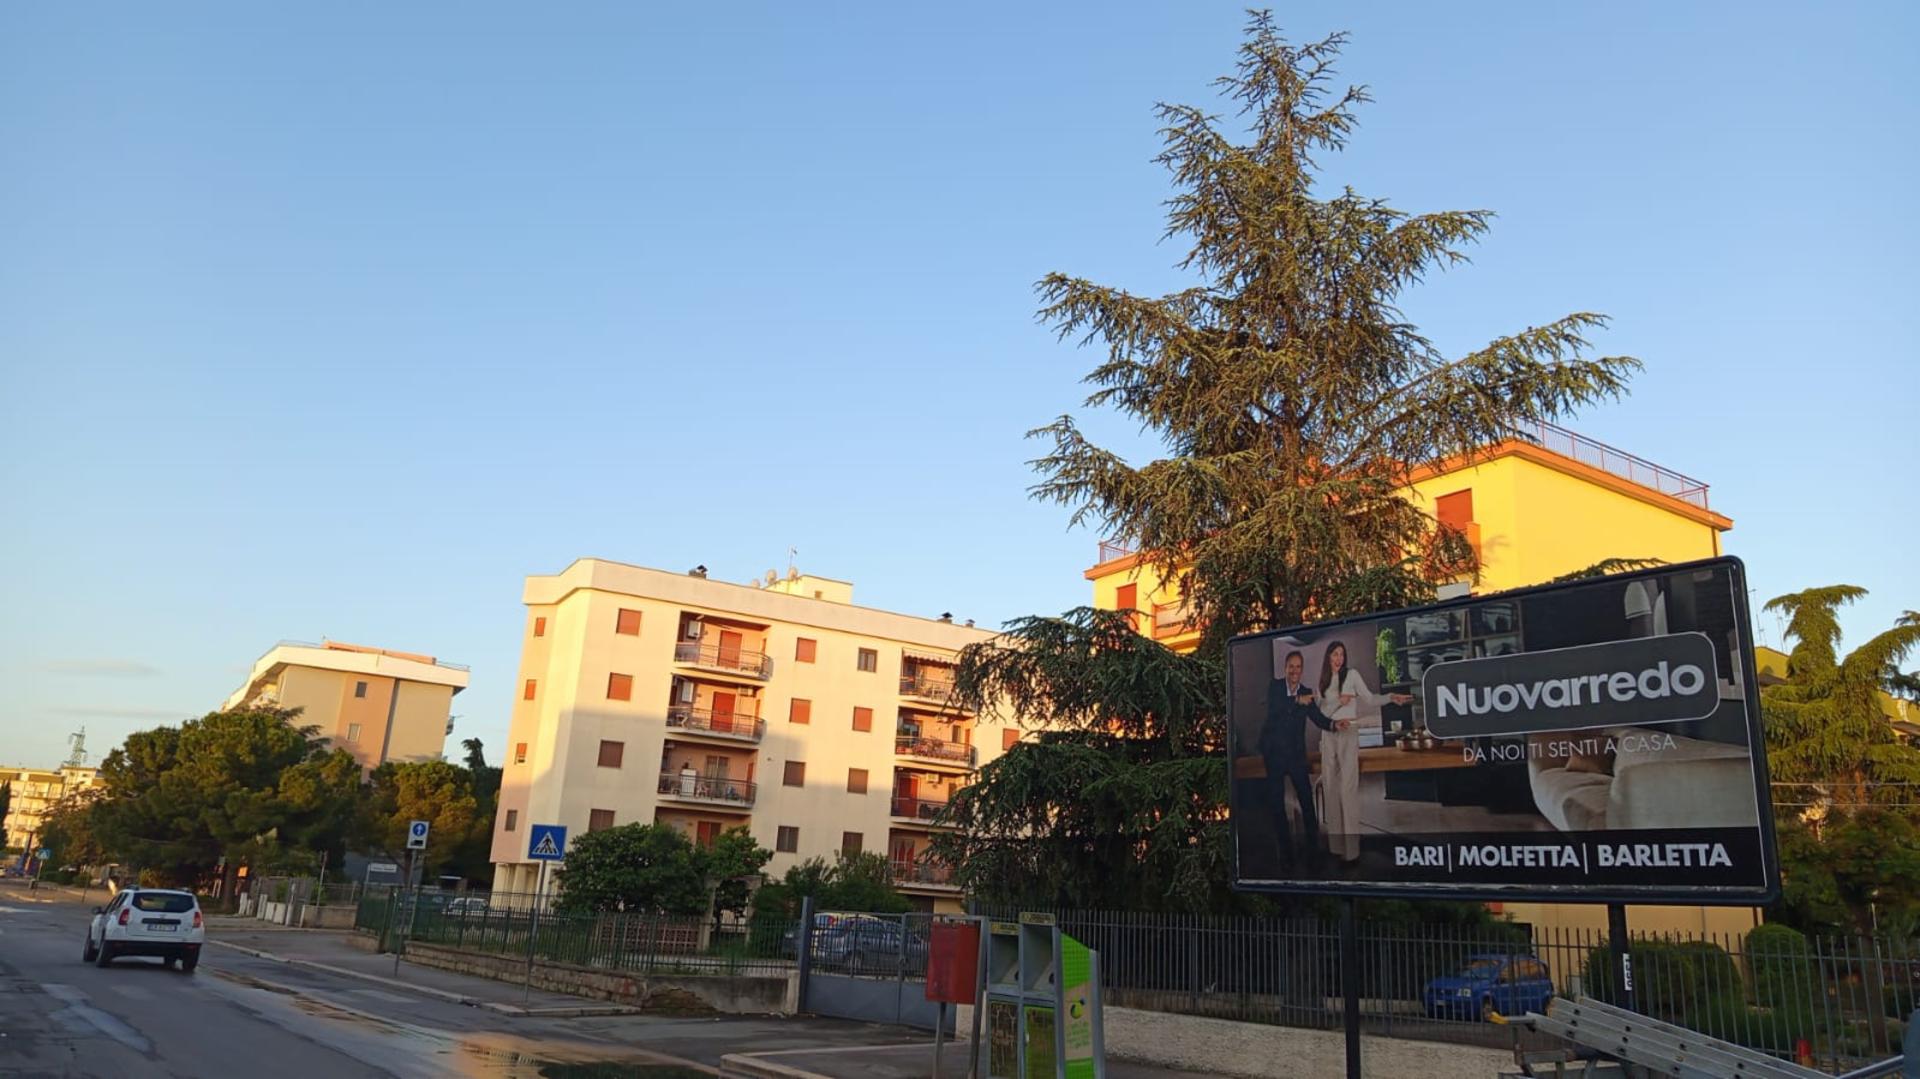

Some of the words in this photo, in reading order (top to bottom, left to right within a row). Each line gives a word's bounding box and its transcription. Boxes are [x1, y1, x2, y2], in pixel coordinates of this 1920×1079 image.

[1436, 660, 1705, 718] Nuovarredo
[1463, 747, 1487, 763] DA
[1491, 744, 1526, 761] NOI
[1529, 742, 1544, 759] TI
[1548, 738, 1599, 759] SENTI
[1603, 736, 1618, 753] A
[1622, 733, 1678, 752] CASA
[1394, 846, 1444, 867] BARI
[1458, 845, 1581, 868] MOLFETTA
[1597, 843, 1733, 867] BARLETTA
